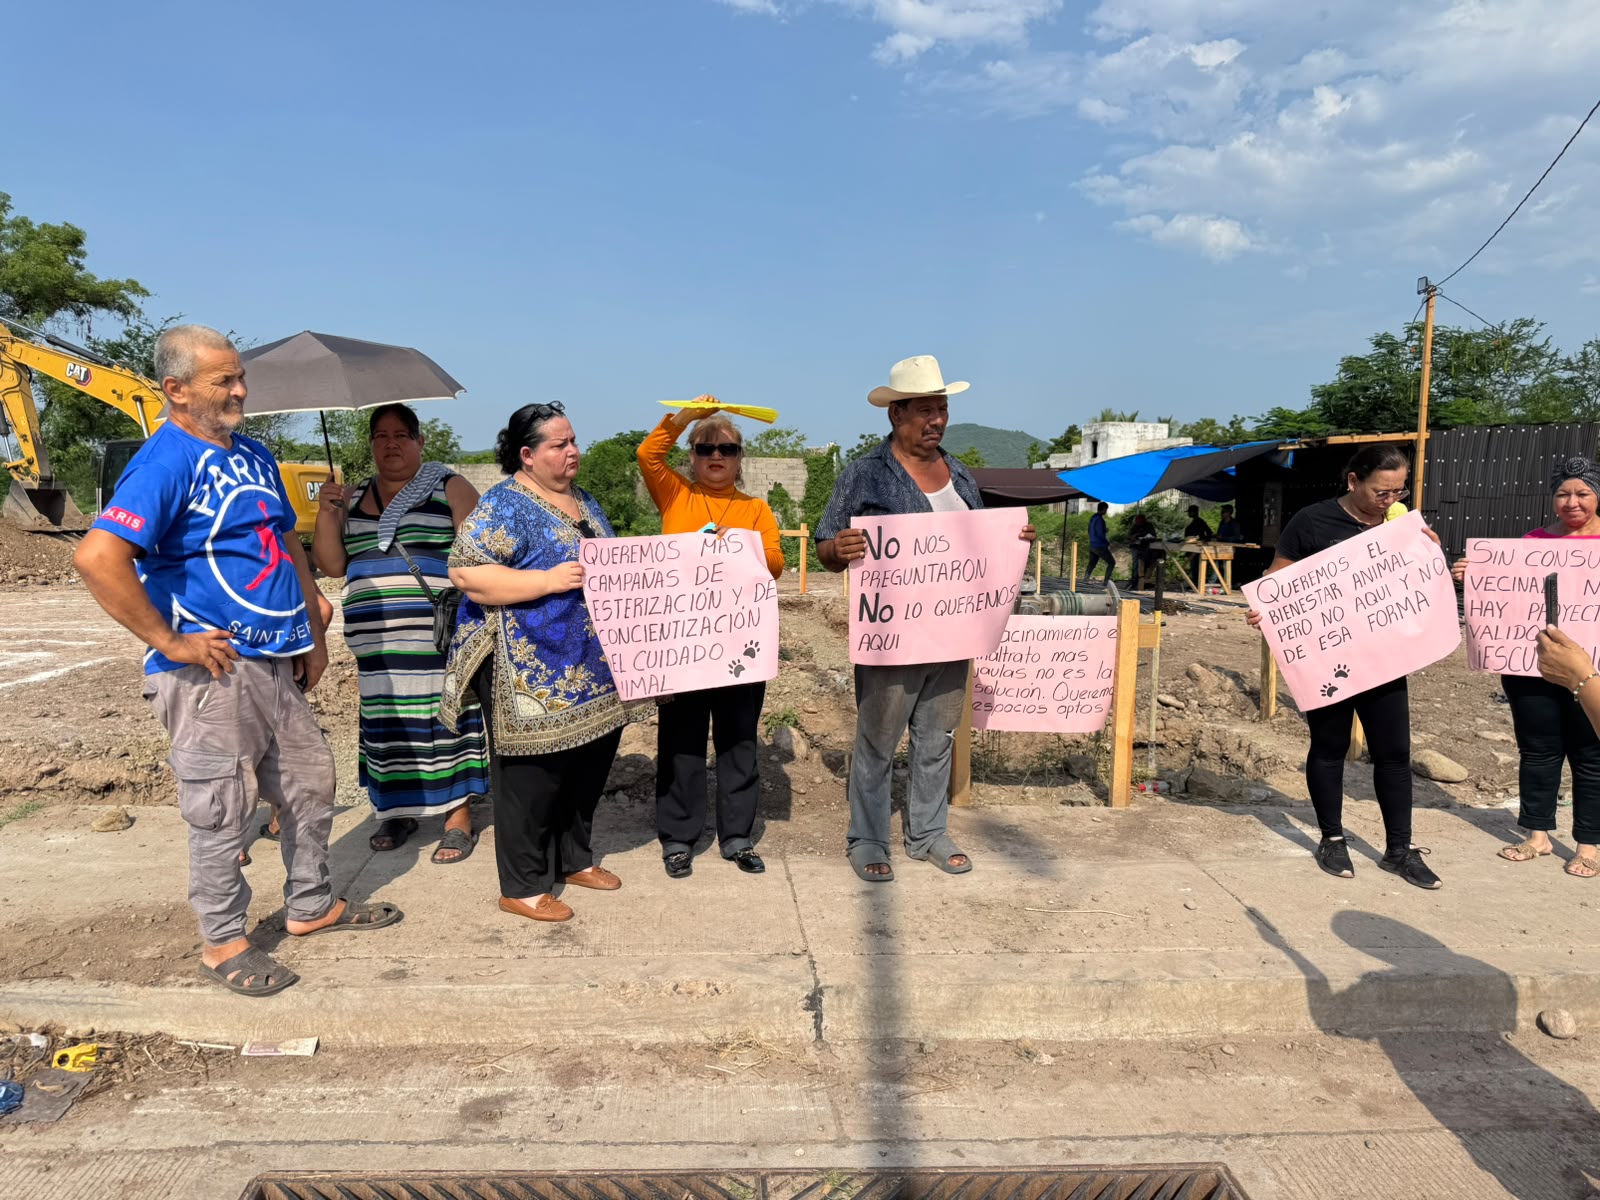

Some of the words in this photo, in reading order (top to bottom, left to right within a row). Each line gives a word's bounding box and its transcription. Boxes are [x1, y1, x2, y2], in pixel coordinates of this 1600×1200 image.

[66, 362, 88, 381] CAT
[583, 540, 681, 566] QUEREMOS
[700, 533, 744, 558] MAS
[862, 525, 900, 561] No
[913, 535, 950, 556] NOS
[1469, 540, 1516, 566] SIN
[1524, 549, 1600, 570] CONSU
[588, 567, 680, 593] CAMPAÑAS
[694, 562, 724, 586] DE
[860, 557, 987, 588] PREGUNTARON
[1256, 556, 1350, 605] QUEREMOS
[1366, 541, 1388, 559] EL
[1268, 582, 1343, 625] BIENESTAR
[1352, 551, 1414, 591] ANIMAL
[1583, 579, 1600, 597] N
[592, 587, 722, 621] ESTERIZACIÓN
[731, 586, 743, 606] Y
[753, 579, 777, 603] DE
[858, 592, 894, 623] No
[904, 601, 922, 621] LO
[934, 583, 1017, 617] QUEREMOS
[1277, 618, 1313, 643] PERO
[1321, 605, 1345, 627] NO
[1355, 583, 1392, 613] AQUI
[1399, 573, 1409, 591] Y
[1418, 556, 1446, 583] NO
[1470, 600, 1509, 619] HAY
[599, 605, 761, 646] CONCIENTIZACIÓN
[1000, 620, 1099, 643] acinamiento
[1282, 644, 1307, 665] DE
[1318, 625, 1353, 652] ESA
[1366, 589, 1431, 633] FORMA
[1469, 624, 1541, 642] VALIDO
[608, 652, 627, 674] EL
[632, 642, 724, 671] CUIDADO
[858, 633, 900, 652] AQUI
[1051, 650, 1089, 663] mas
[972, 663, 1027, 679] jaulas
[1035, 668, 1055, 680] no
[1063, 668, 1086, 680] es
[1096, 660, 1113, 680] la
[620, 674, 674, 698] IMAL
